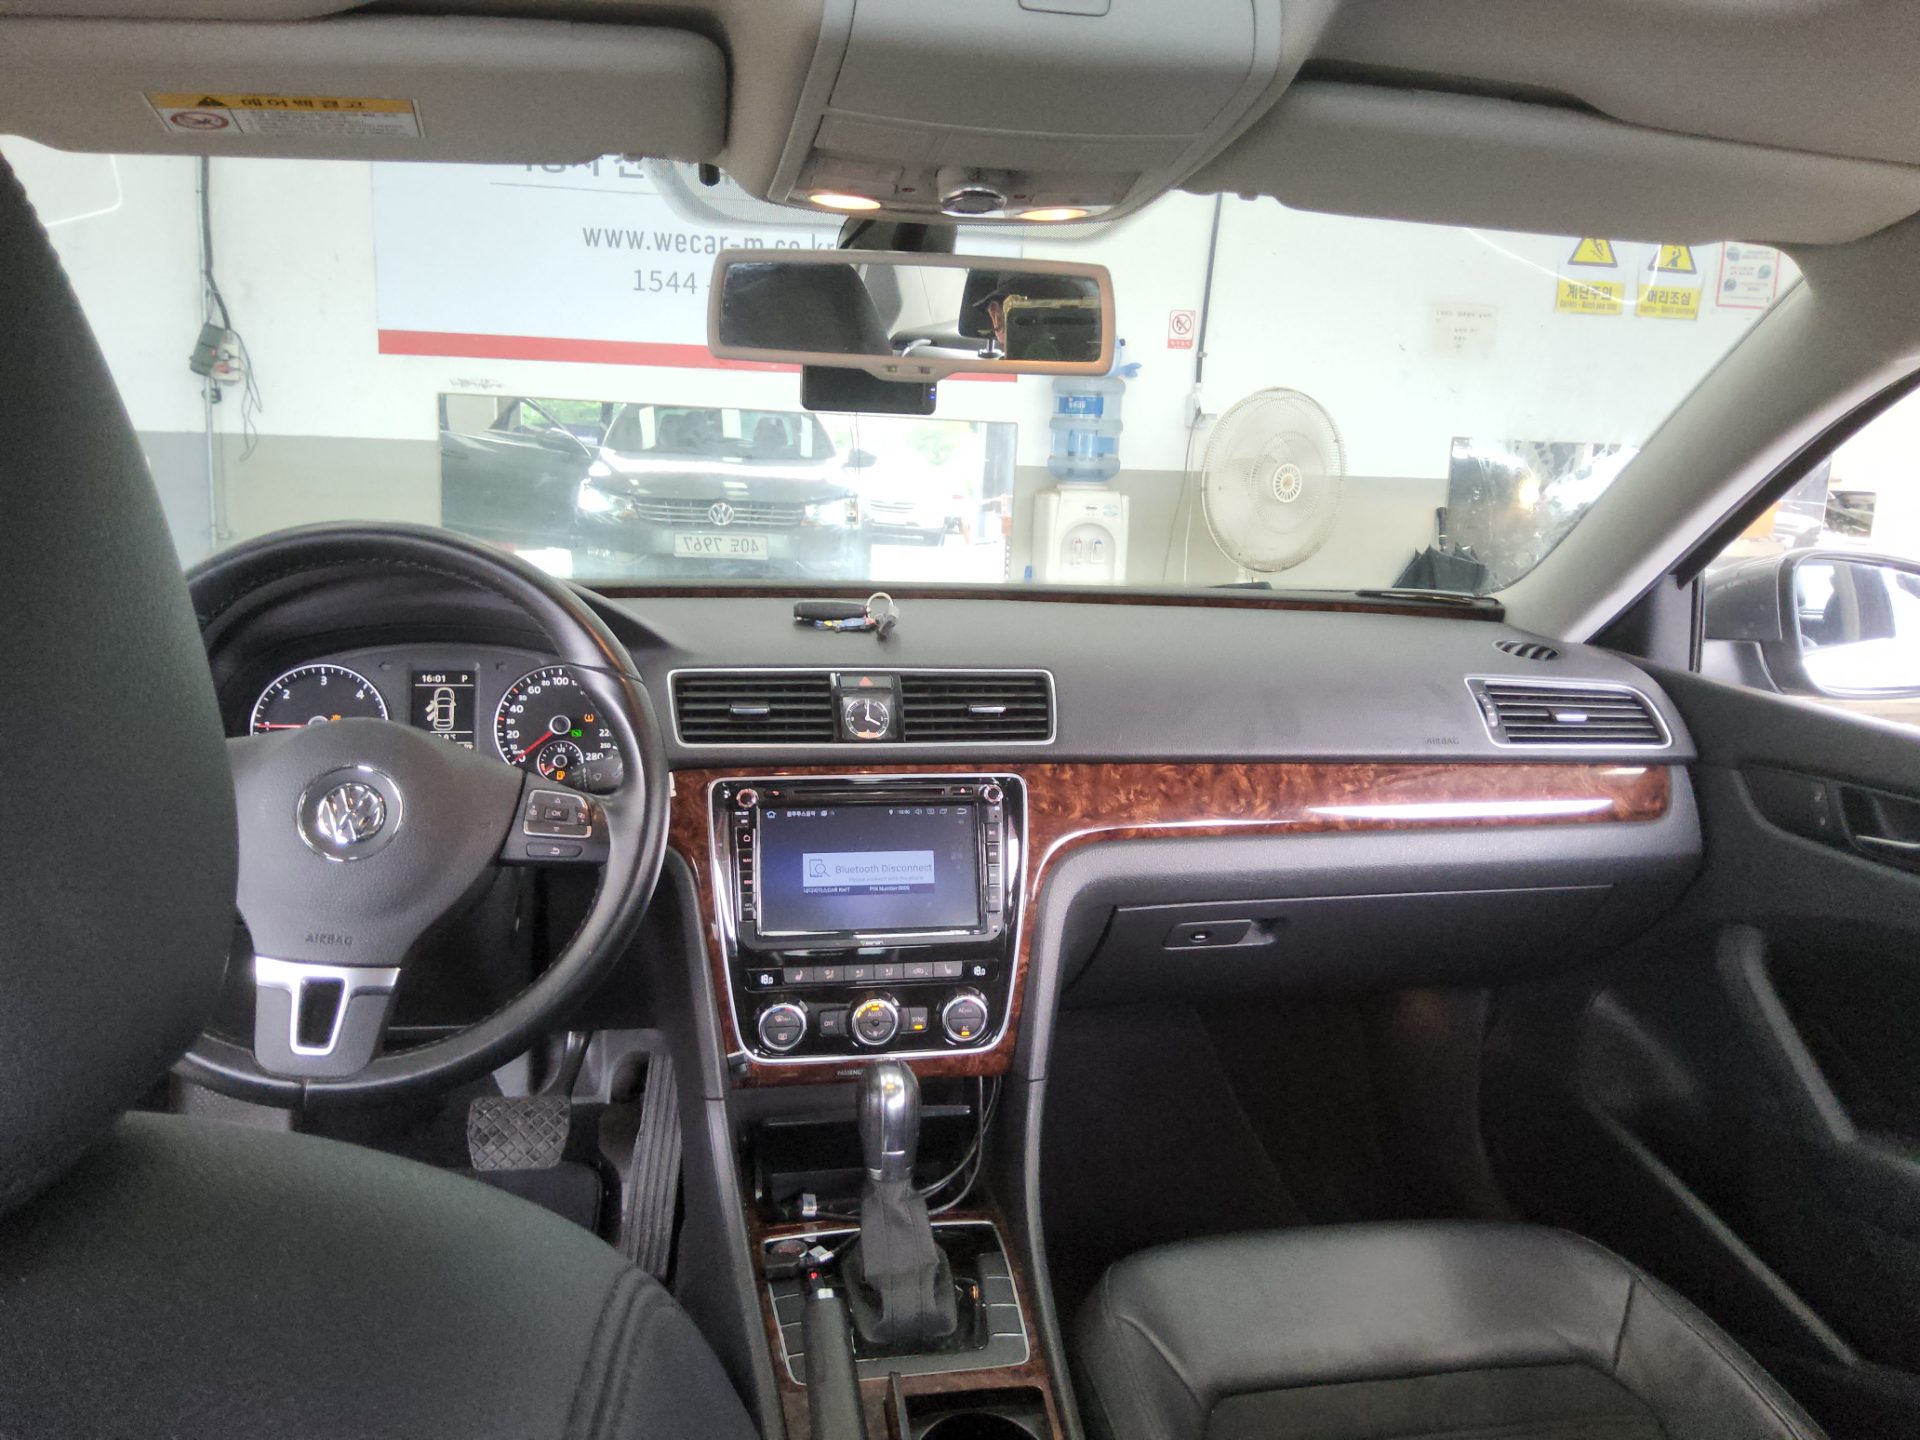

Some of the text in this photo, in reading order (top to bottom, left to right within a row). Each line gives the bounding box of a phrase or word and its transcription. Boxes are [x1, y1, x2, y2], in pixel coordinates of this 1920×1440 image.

[582, 225, 837, 256] www.wecar-mcokr
[633, 269, 697, 295] 1544
[320, 675, 328, 686] 3
[422, 674, 468, 683] 16:01 P
[552, 677, 569, 686] 100
[282, 689, 291, 700] 2
[527, 686, 541, 694] 60
[355, 690, 365, 700] 4
[509, 705, 524, 713] 40
[506, 730, 520, 739] 20
[599, 728, 611, 738] 22
[835, 862, 933, 875] Bluetooth Disconnect
[304, 932, 353, 945] AIRBAG
[867, 1010, 883, 1018] AUTO
[823, 1019, 835, 1028] OFF
[911, 1015, 926, 1024] SYNC
